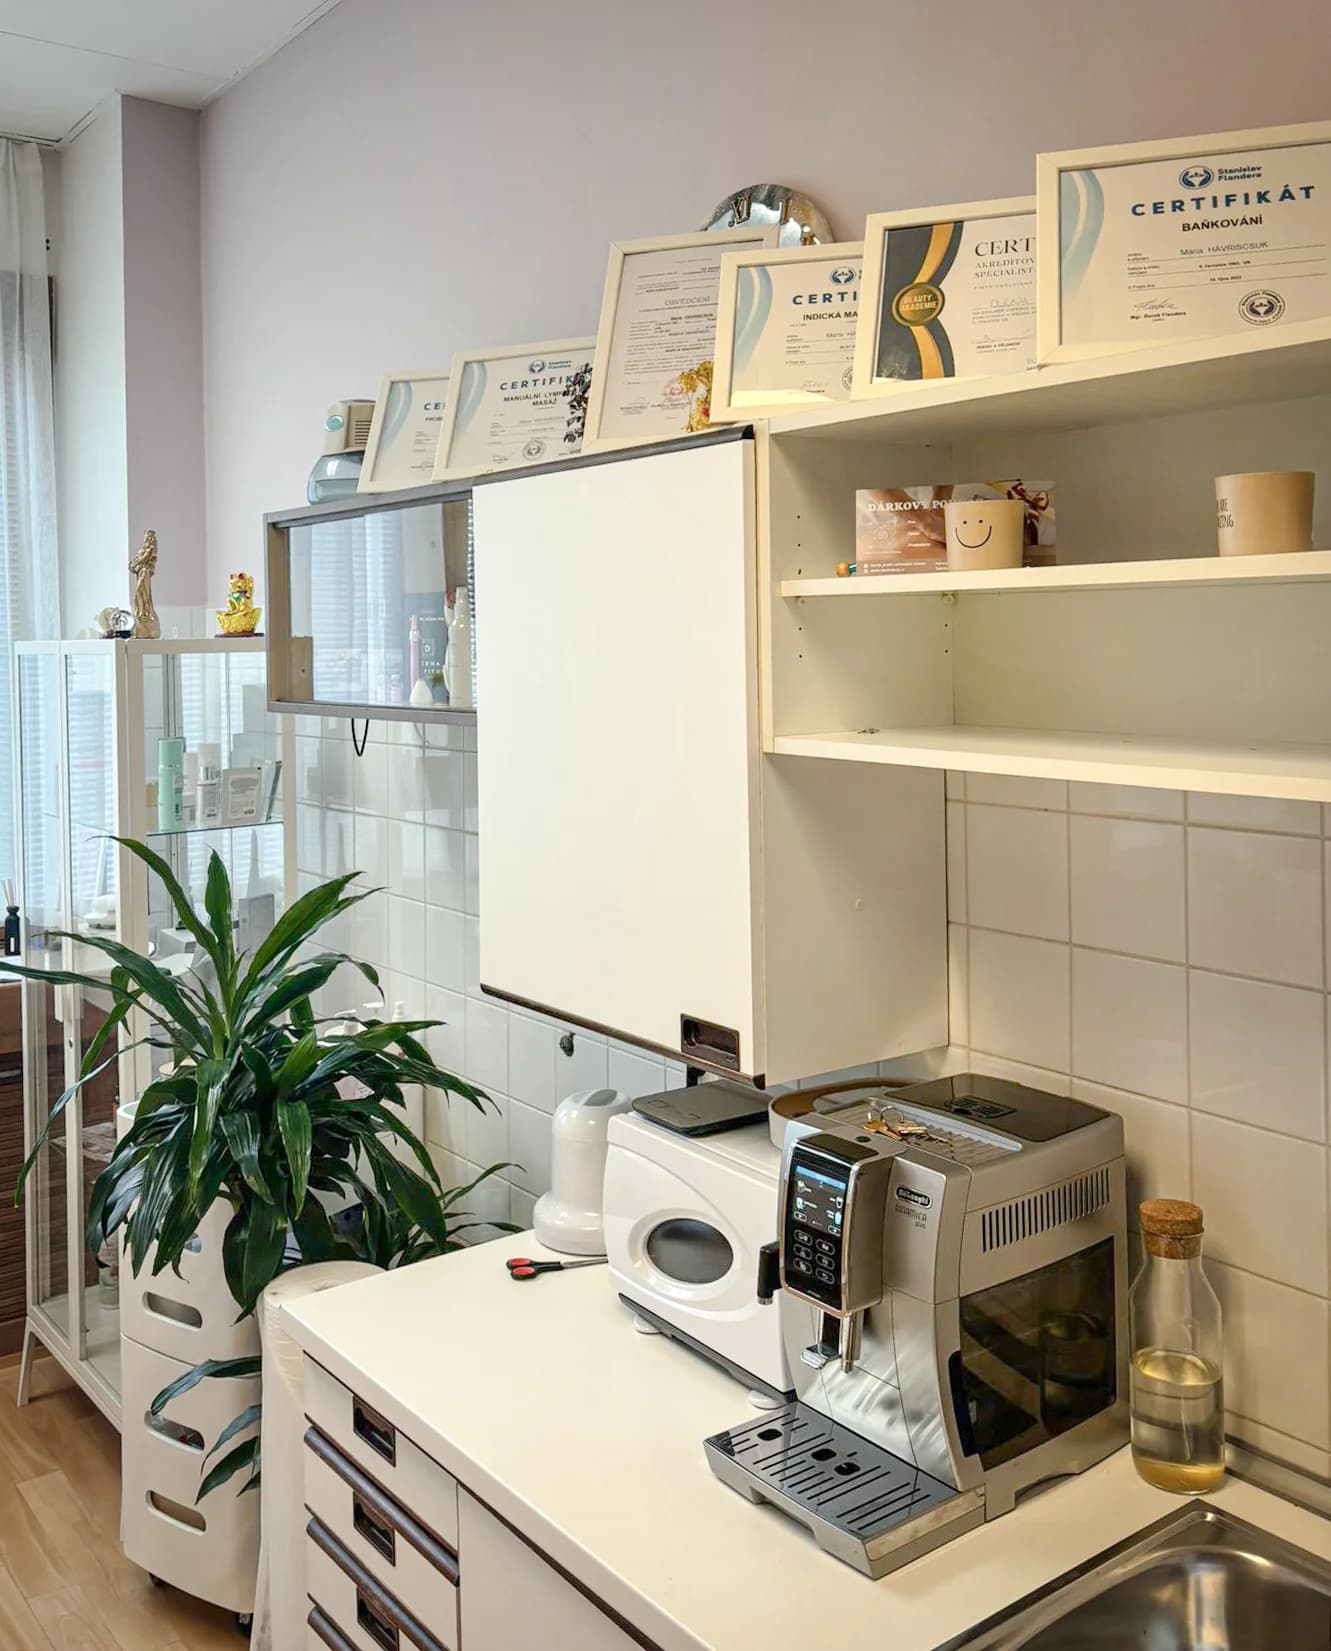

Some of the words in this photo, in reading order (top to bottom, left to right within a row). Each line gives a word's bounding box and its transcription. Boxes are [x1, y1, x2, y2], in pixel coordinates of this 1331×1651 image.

[1131, 184, 1316, 216] CERTIFIKÁT
[1181, 214, 1263, 232] BAŇKOVÁNÍ
[792, 291, 857, 305] CERTI
[424, 402, 446, 411] CE
